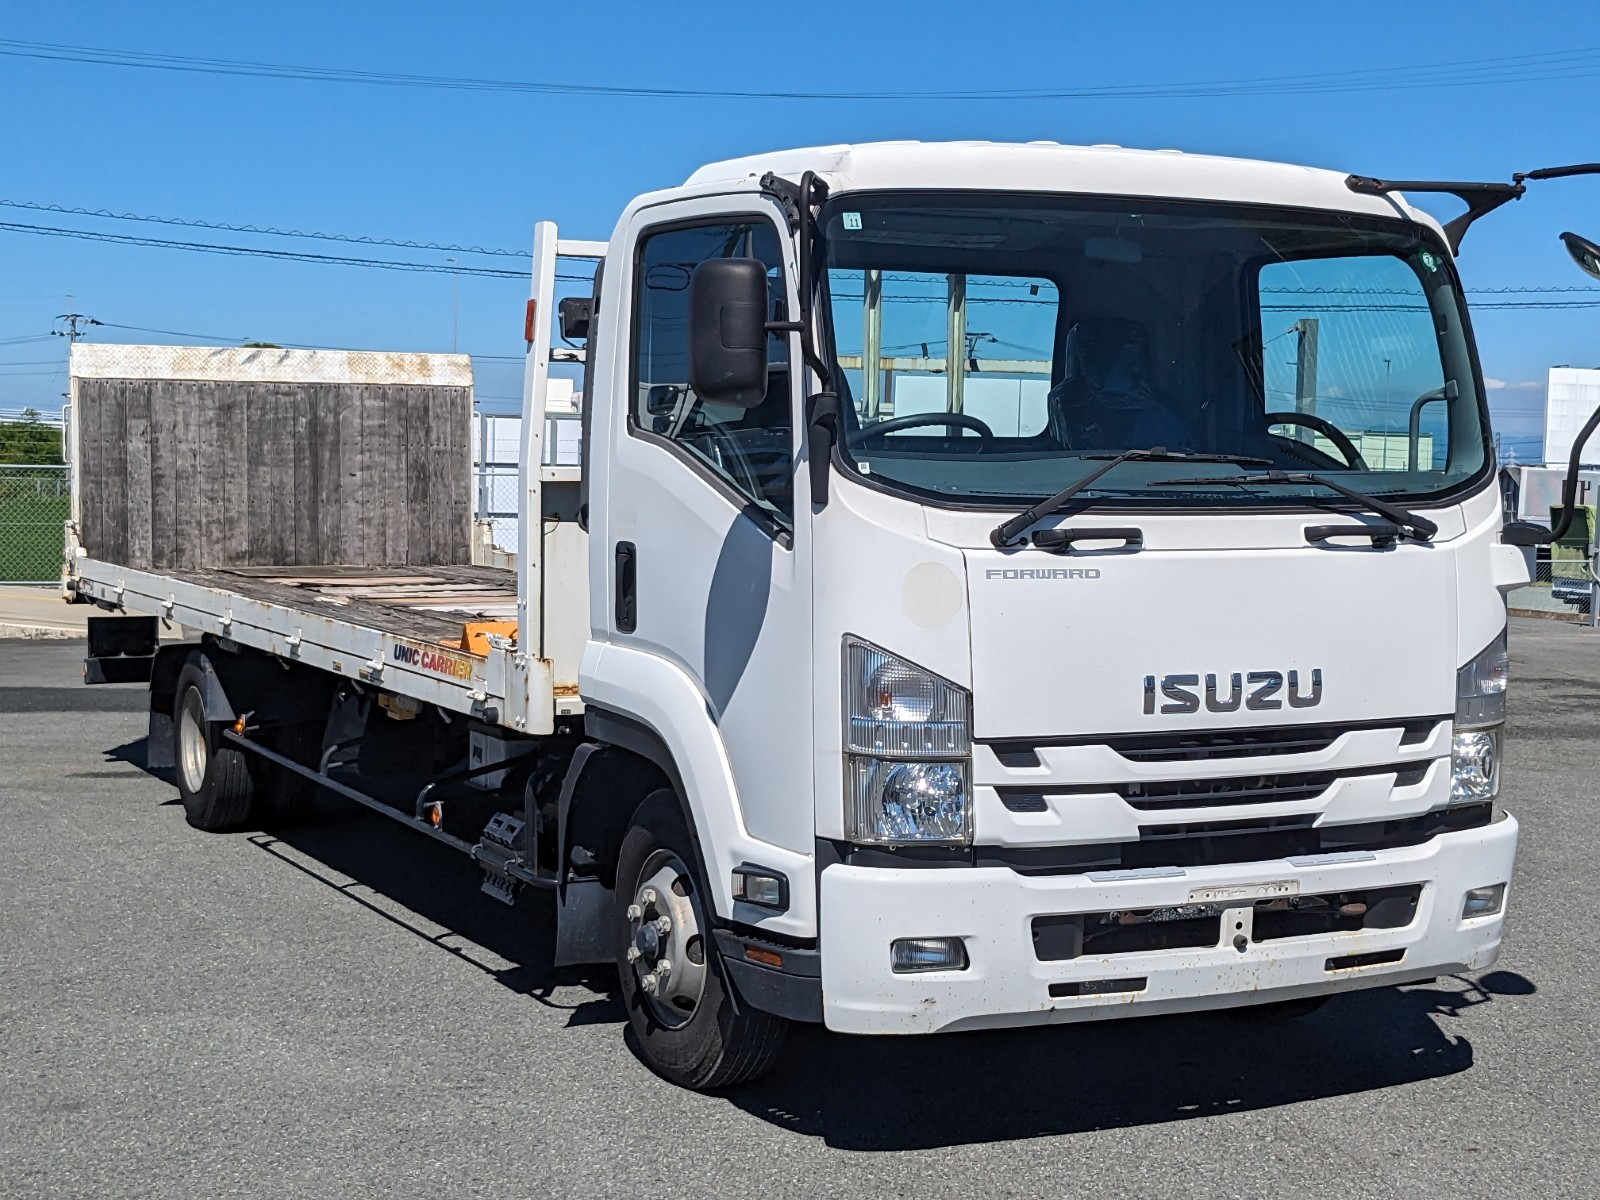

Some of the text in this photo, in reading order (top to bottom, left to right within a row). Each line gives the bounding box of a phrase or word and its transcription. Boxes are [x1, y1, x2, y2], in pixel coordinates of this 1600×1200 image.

[985, 568, 1101, 580] FORWARD
[394, 643, 472, 681] UNIC CARRIER
[1143, 668, 1322, 715] ISUZU
